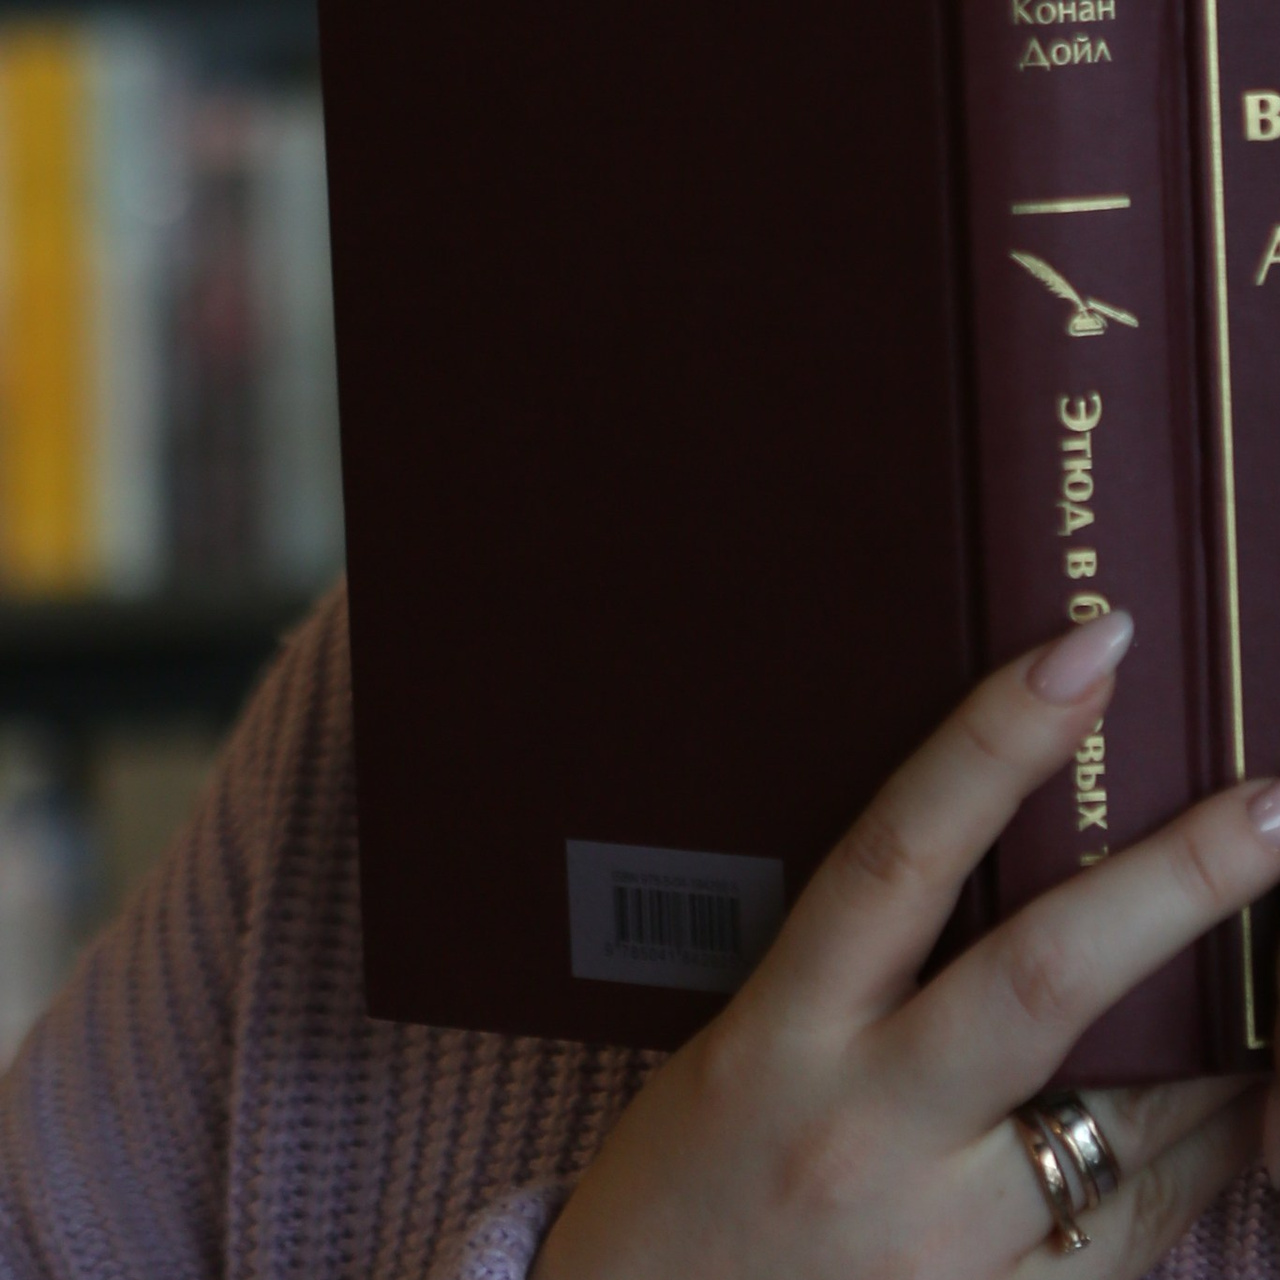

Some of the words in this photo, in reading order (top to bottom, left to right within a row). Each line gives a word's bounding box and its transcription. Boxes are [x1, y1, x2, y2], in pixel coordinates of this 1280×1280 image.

[1019, 34, 1113, 71] Дойл
[1059, 392, 1103, 536] Этюд
[1066, 549, 1098, 580] в
